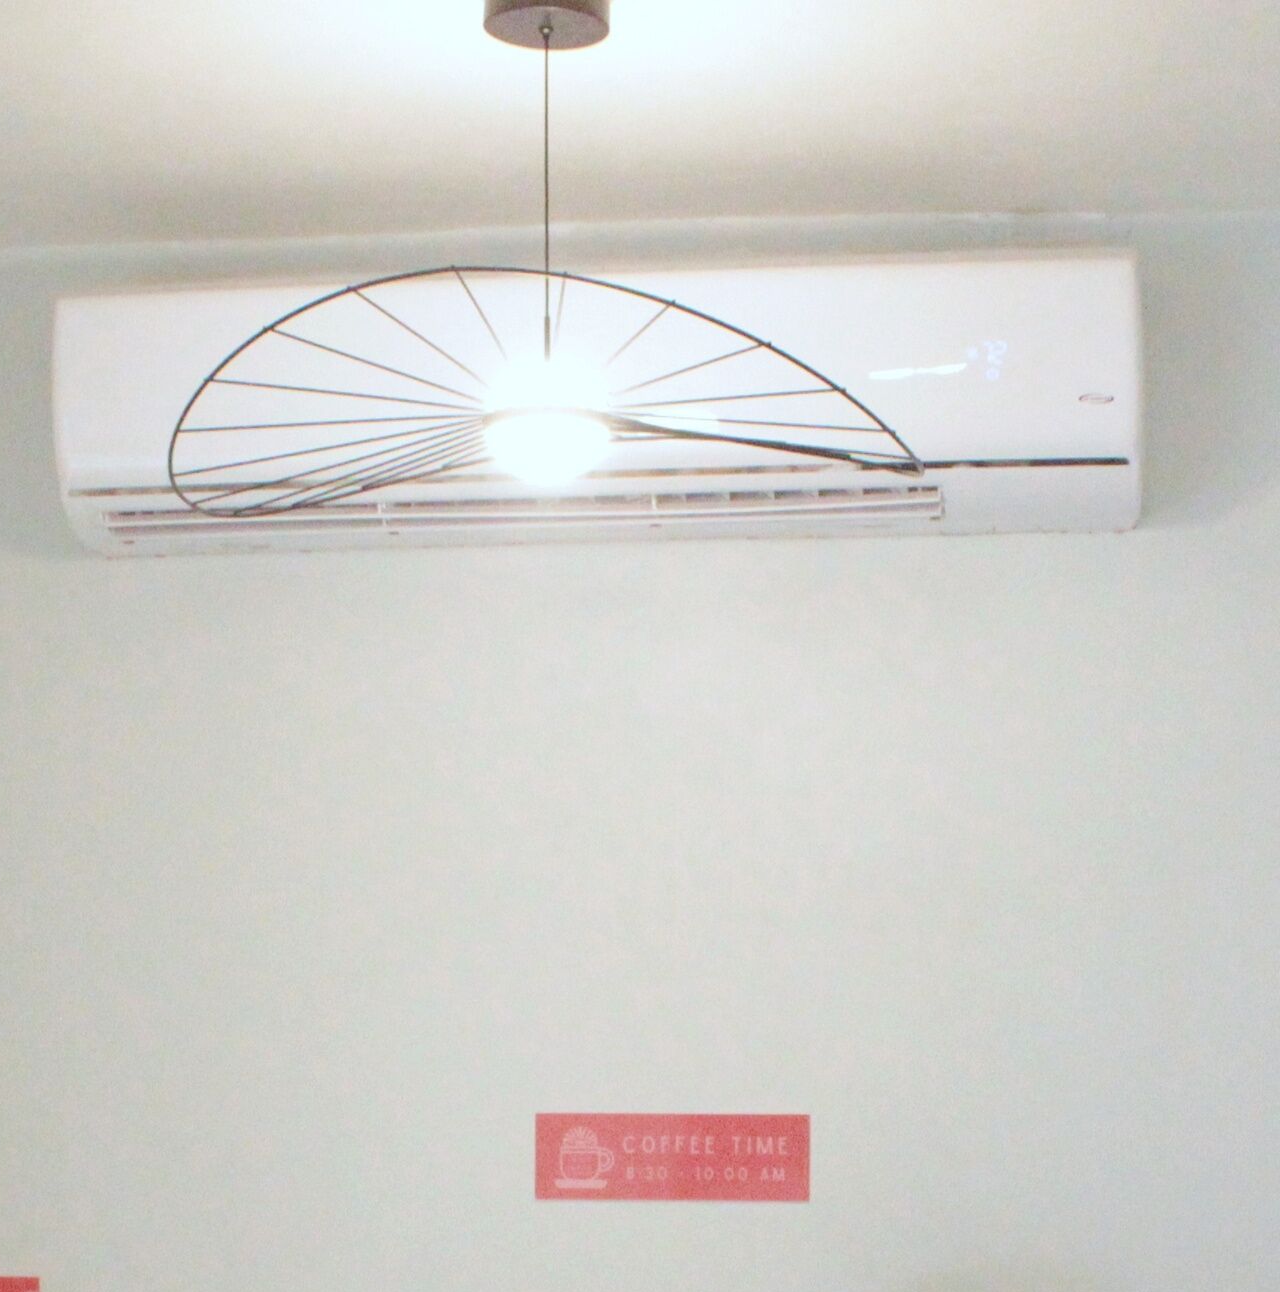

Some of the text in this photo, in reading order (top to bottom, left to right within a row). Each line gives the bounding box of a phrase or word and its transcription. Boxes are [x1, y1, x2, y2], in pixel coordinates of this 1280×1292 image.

[621, 1135, 789, 1156] COFFEE TIME
[624, 1165, 669, 1181] 830
[694, 1165, 749, 1182] 1000
[760, 1166, 786, 1182] AM
